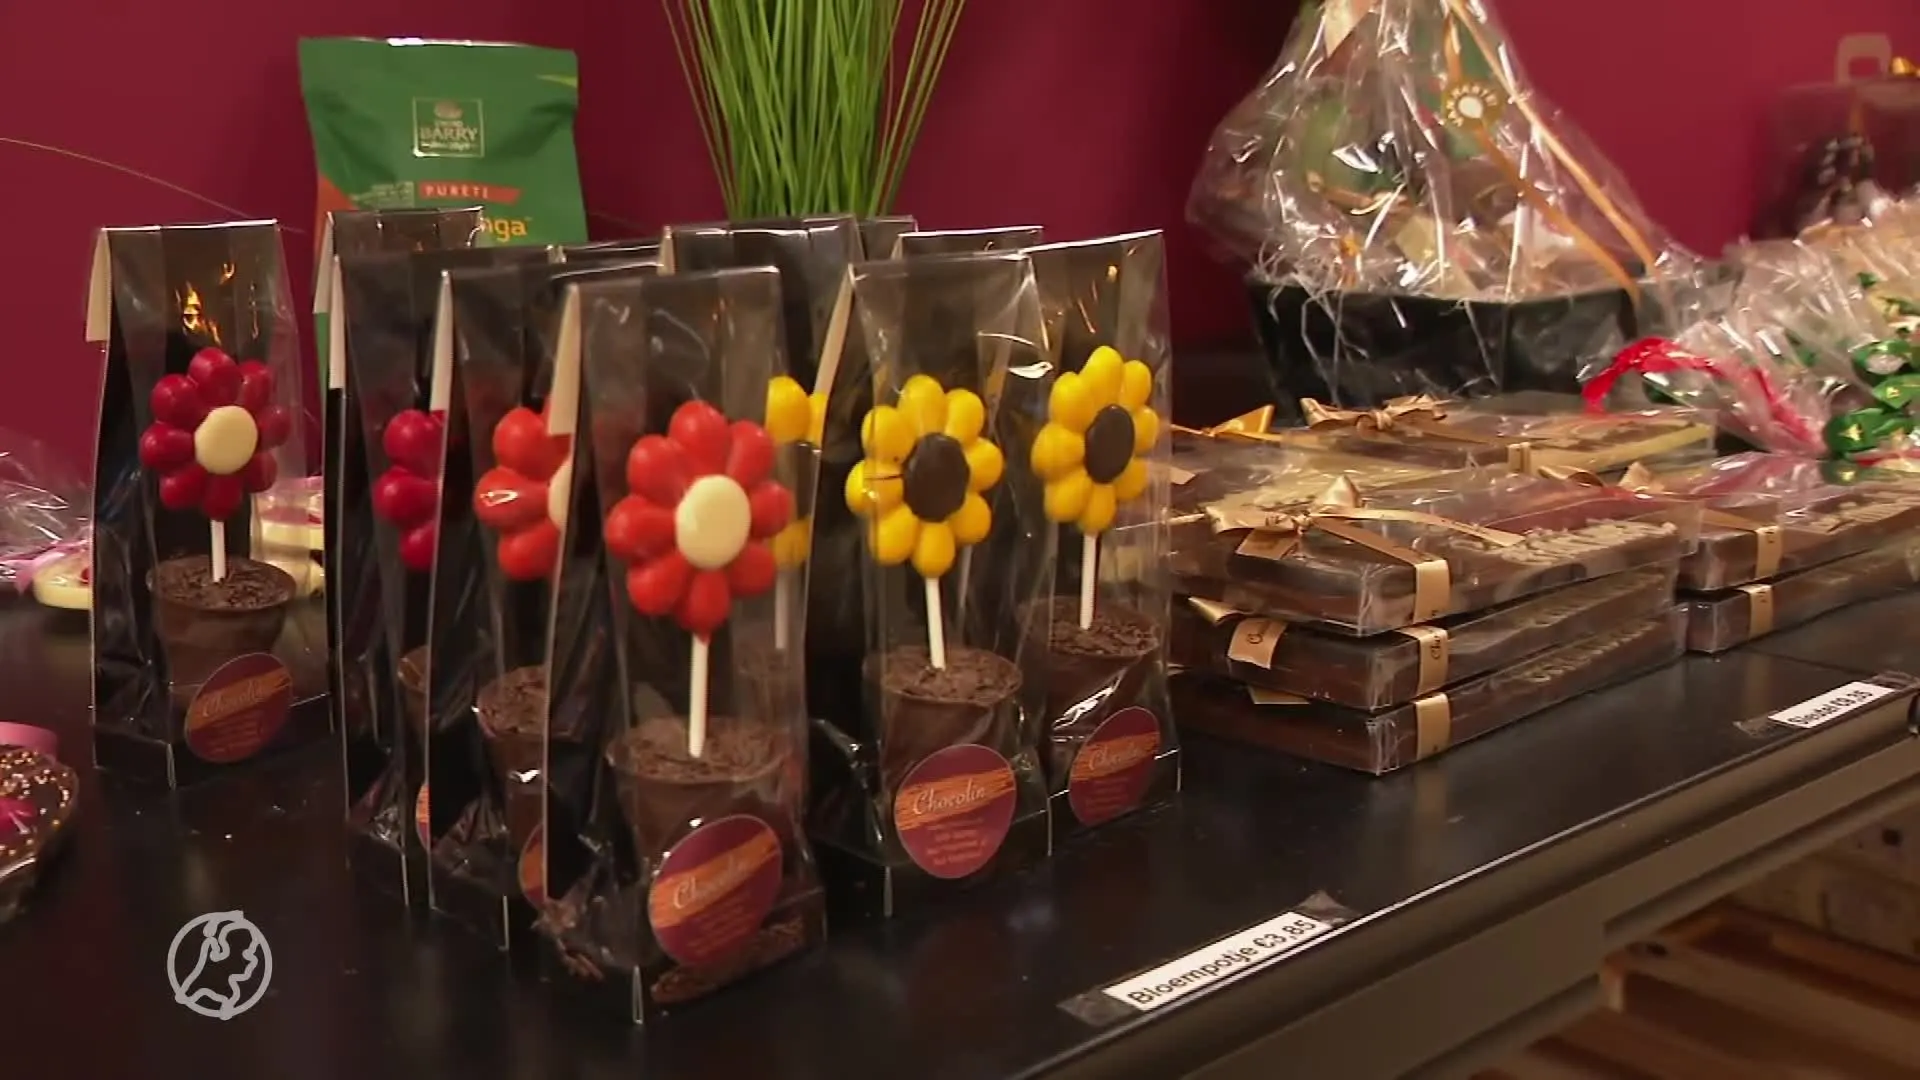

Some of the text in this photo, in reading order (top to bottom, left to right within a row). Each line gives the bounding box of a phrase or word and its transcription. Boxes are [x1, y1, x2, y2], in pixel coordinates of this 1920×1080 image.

[420, 126, 478, 142] BARRY
[481, 217, 527, 242] nga
[1127, 919, 1317, 1004] Bloempotje €3,85
